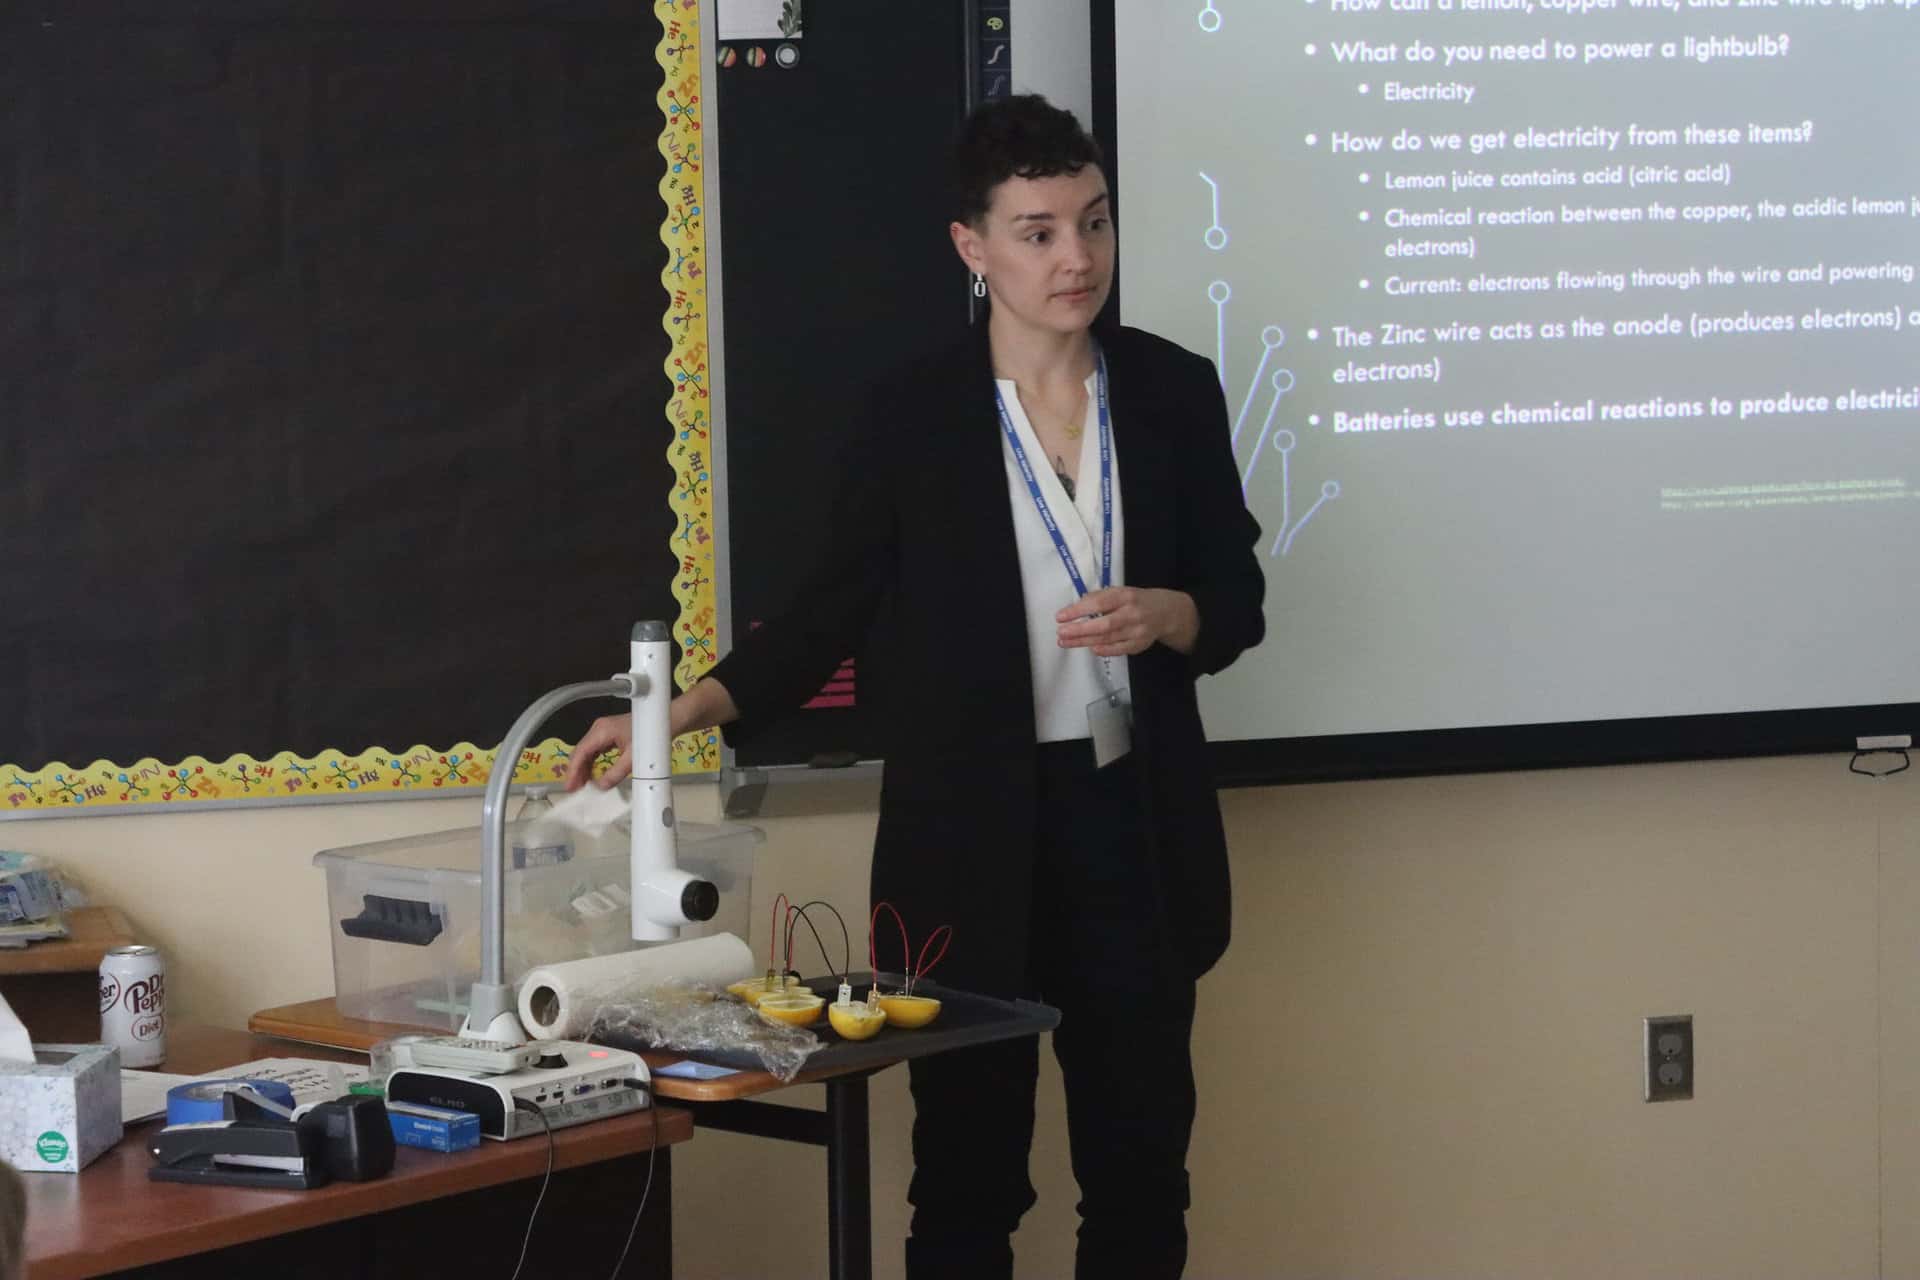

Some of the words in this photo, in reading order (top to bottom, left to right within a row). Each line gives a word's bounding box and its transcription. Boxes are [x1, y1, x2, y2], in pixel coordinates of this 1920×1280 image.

[1331, 41, 1397, 62] What
[1405, 40, 1435, 61] do
[1443, 46, 1482, 66] you
[1490, 39, 1546, 59] need
[1555, 42, 1576, 58] to
[1585, 43, 1653, 64] power
[1661, 43, 1675, 57] a
[1684, 34, 1789, 62] lightbulb?
[1385, 82, 1474, 103] Electricity
[1332, 132, 1382, 152] How
[1392, 129, 1421, 150] do
[1430, 134, 1461, 149] we
[1470, 131, 1506, 154] get
[1514, 126, 1619, 150] electricity
[1628, 124, 1676, 145] from
[1684, 123, 1741, 144] these
[1749, 120, 1812, 143] items?
[1386, 172, 1445, 189] Lemon
[1452, 171, 1494, 192] juice
[1501, 168, 1576, 186] contains
[1583, 166, 1622, 184] acid
[1630, 166, 1677, 187] (citric
[1685, 164, 1730, 185] acid)
[1385, 208, 1471, 227] Chemical
[1478, 207, 1554, 224] reaction
[1562, 205, 1642, 222] between
[1648, 202, 1676, 219] the
[1683, 206, 1752, 222] copper,
[1758, 200, 1786, 217] the
[1793, 198, 1846, 216] acidic
[1853, 197, 1905, 214] lemon
[1385, 237, 1474, 258] electrons)
[1385, 276, 1461, 294] Current:
[1468, 274, 1550, 291] electrons
[1557, 271, 1624, 291] flowing
[1632, 268, 1700, 289] through
[1708, 267, 1735, 284] the
[1742, 266, 1781, 282] wire
[1787, 264, 1822, 281] and
[1830, 262, 1913, 284] powering
[1332, 326, 1372, 346] The
[1381, 324, 1425, 344] Zinc
[1434, 322, 1480, 340] wire
[1490, 323, 1532, 340] acts
[1540, 324, 1564, 338] as
[1572, 317, 1605, 336] the
[1613, 314, 1682, 335] anode
[1691, 311, 1794, 337] (produces
[1801, 306, 1901, 330] electrons)
[1333, 357, 1440, 383] electrons)
[1334, 408, 1435, 432] Batteries
[1444, 411, 1484, 426] use
[1492, 400, 1592, 424] chemical
[1601, 397, 1703, 420] reactions
[1710, 397, 1732, 415] to
[1740, 392, 1828, 419] produce
